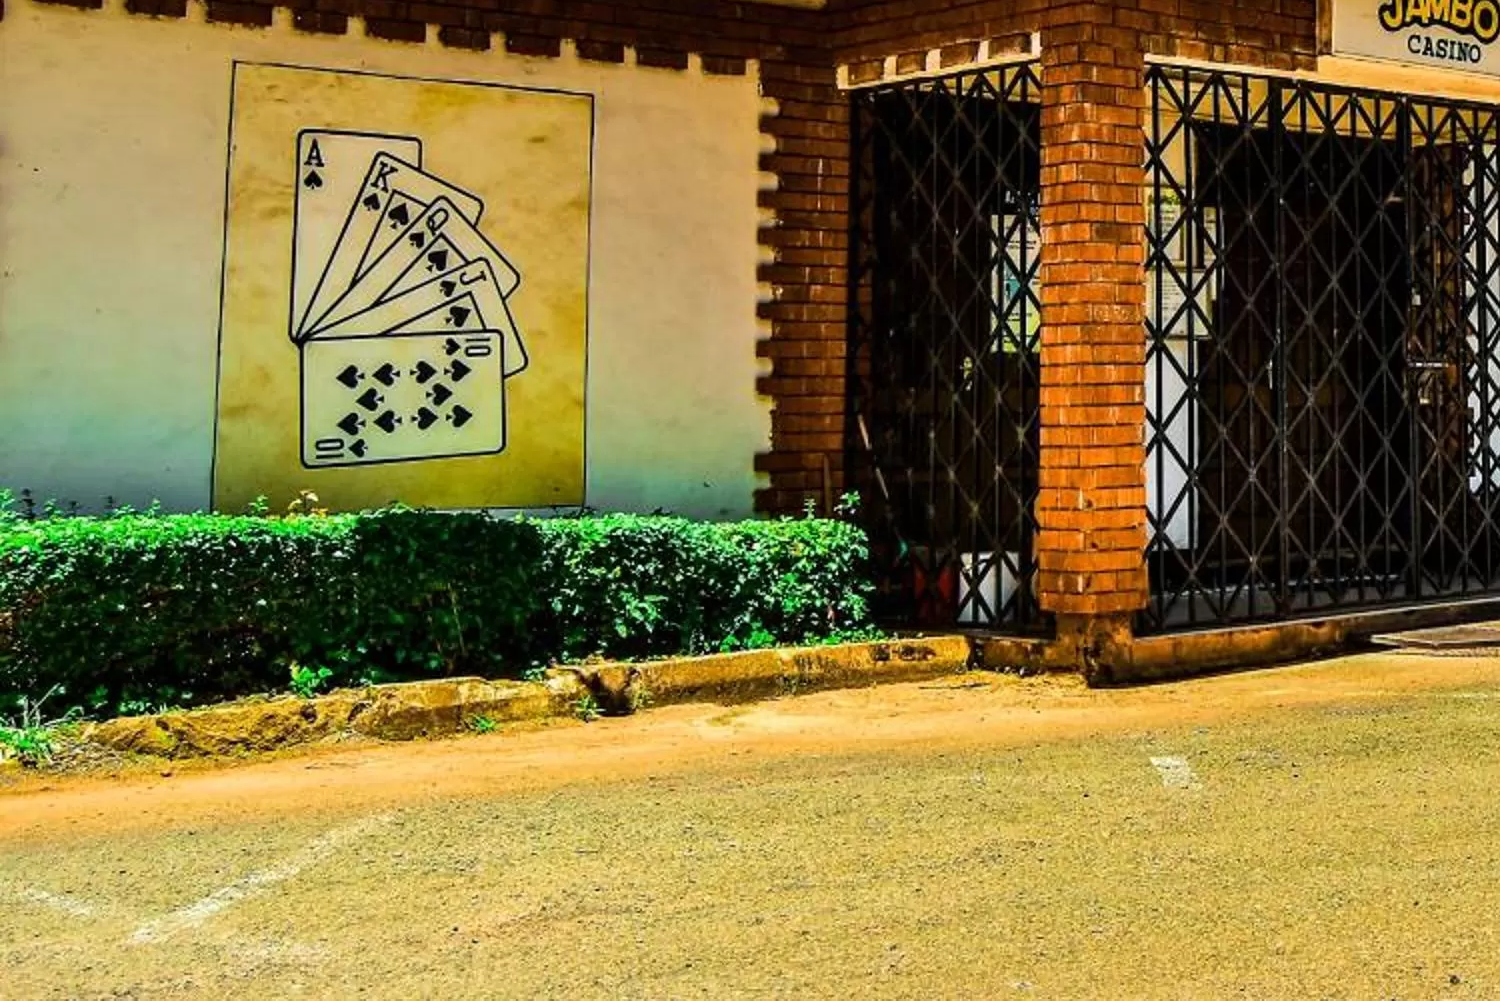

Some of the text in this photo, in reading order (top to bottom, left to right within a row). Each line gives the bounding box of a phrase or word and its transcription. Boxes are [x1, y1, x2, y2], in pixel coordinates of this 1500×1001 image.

[1407, 35, 1481, 63] CASINO
[303, 138, 325, 167] A
[371, 162, 399, 193] K
[425, 207, 450, 237] Q
[459, 269, 486, 287] J
[463, 336, 492, 358] 10
[314, 437, 345, 460] 10
